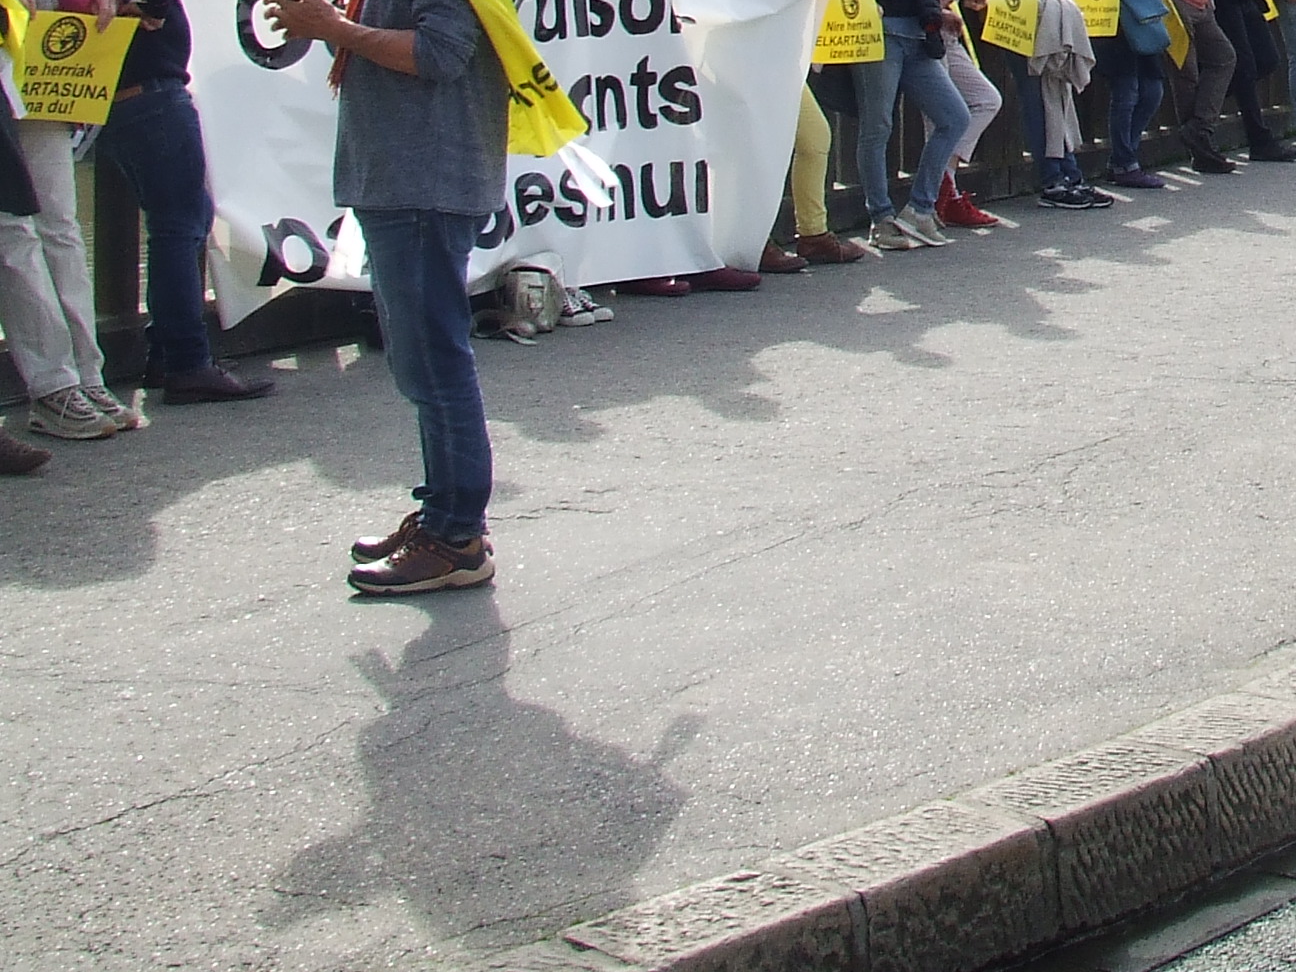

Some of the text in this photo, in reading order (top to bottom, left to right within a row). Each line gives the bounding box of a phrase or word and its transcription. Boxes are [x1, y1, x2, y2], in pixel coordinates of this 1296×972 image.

[826, 20, 845, 32] Nire
[988, 16, 1033, 42] ELKARTASUNA
[815, 33, 882, 46] ELKARTASUNA
[829, 49, 854, 59] izena
[41, 62, 96, 78] herriak
[21, 81, 108, 100] ARTASUNA
[47, 100, 75, 115] du!
